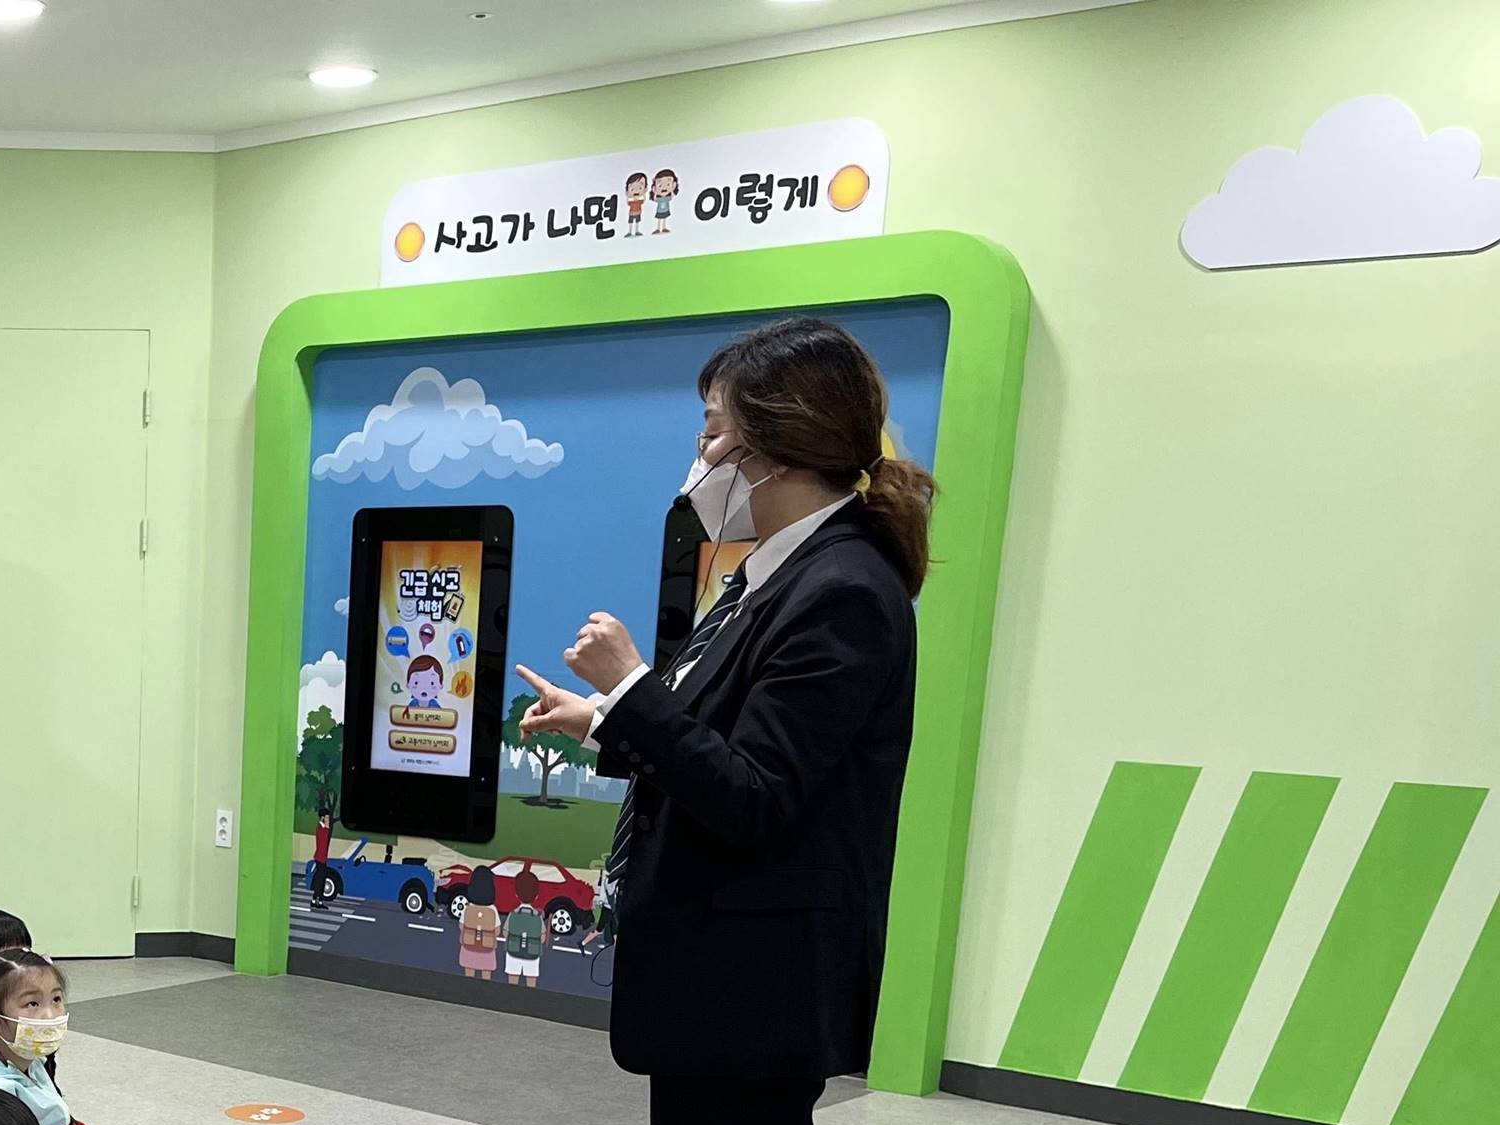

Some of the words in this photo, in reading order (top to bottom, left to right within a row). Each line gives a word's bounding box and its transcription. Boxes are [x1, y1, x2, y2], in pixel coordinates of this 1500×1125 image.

[434, 212, 535, 253] 사고가
[547, 194, 617, 240] 나면
[694, 173, 819, 224] 이렇게
[401, 571, 429, 597] 긴급
[431, 571, 459, 597] 신고
[418, 600, 442, 620] 체험
